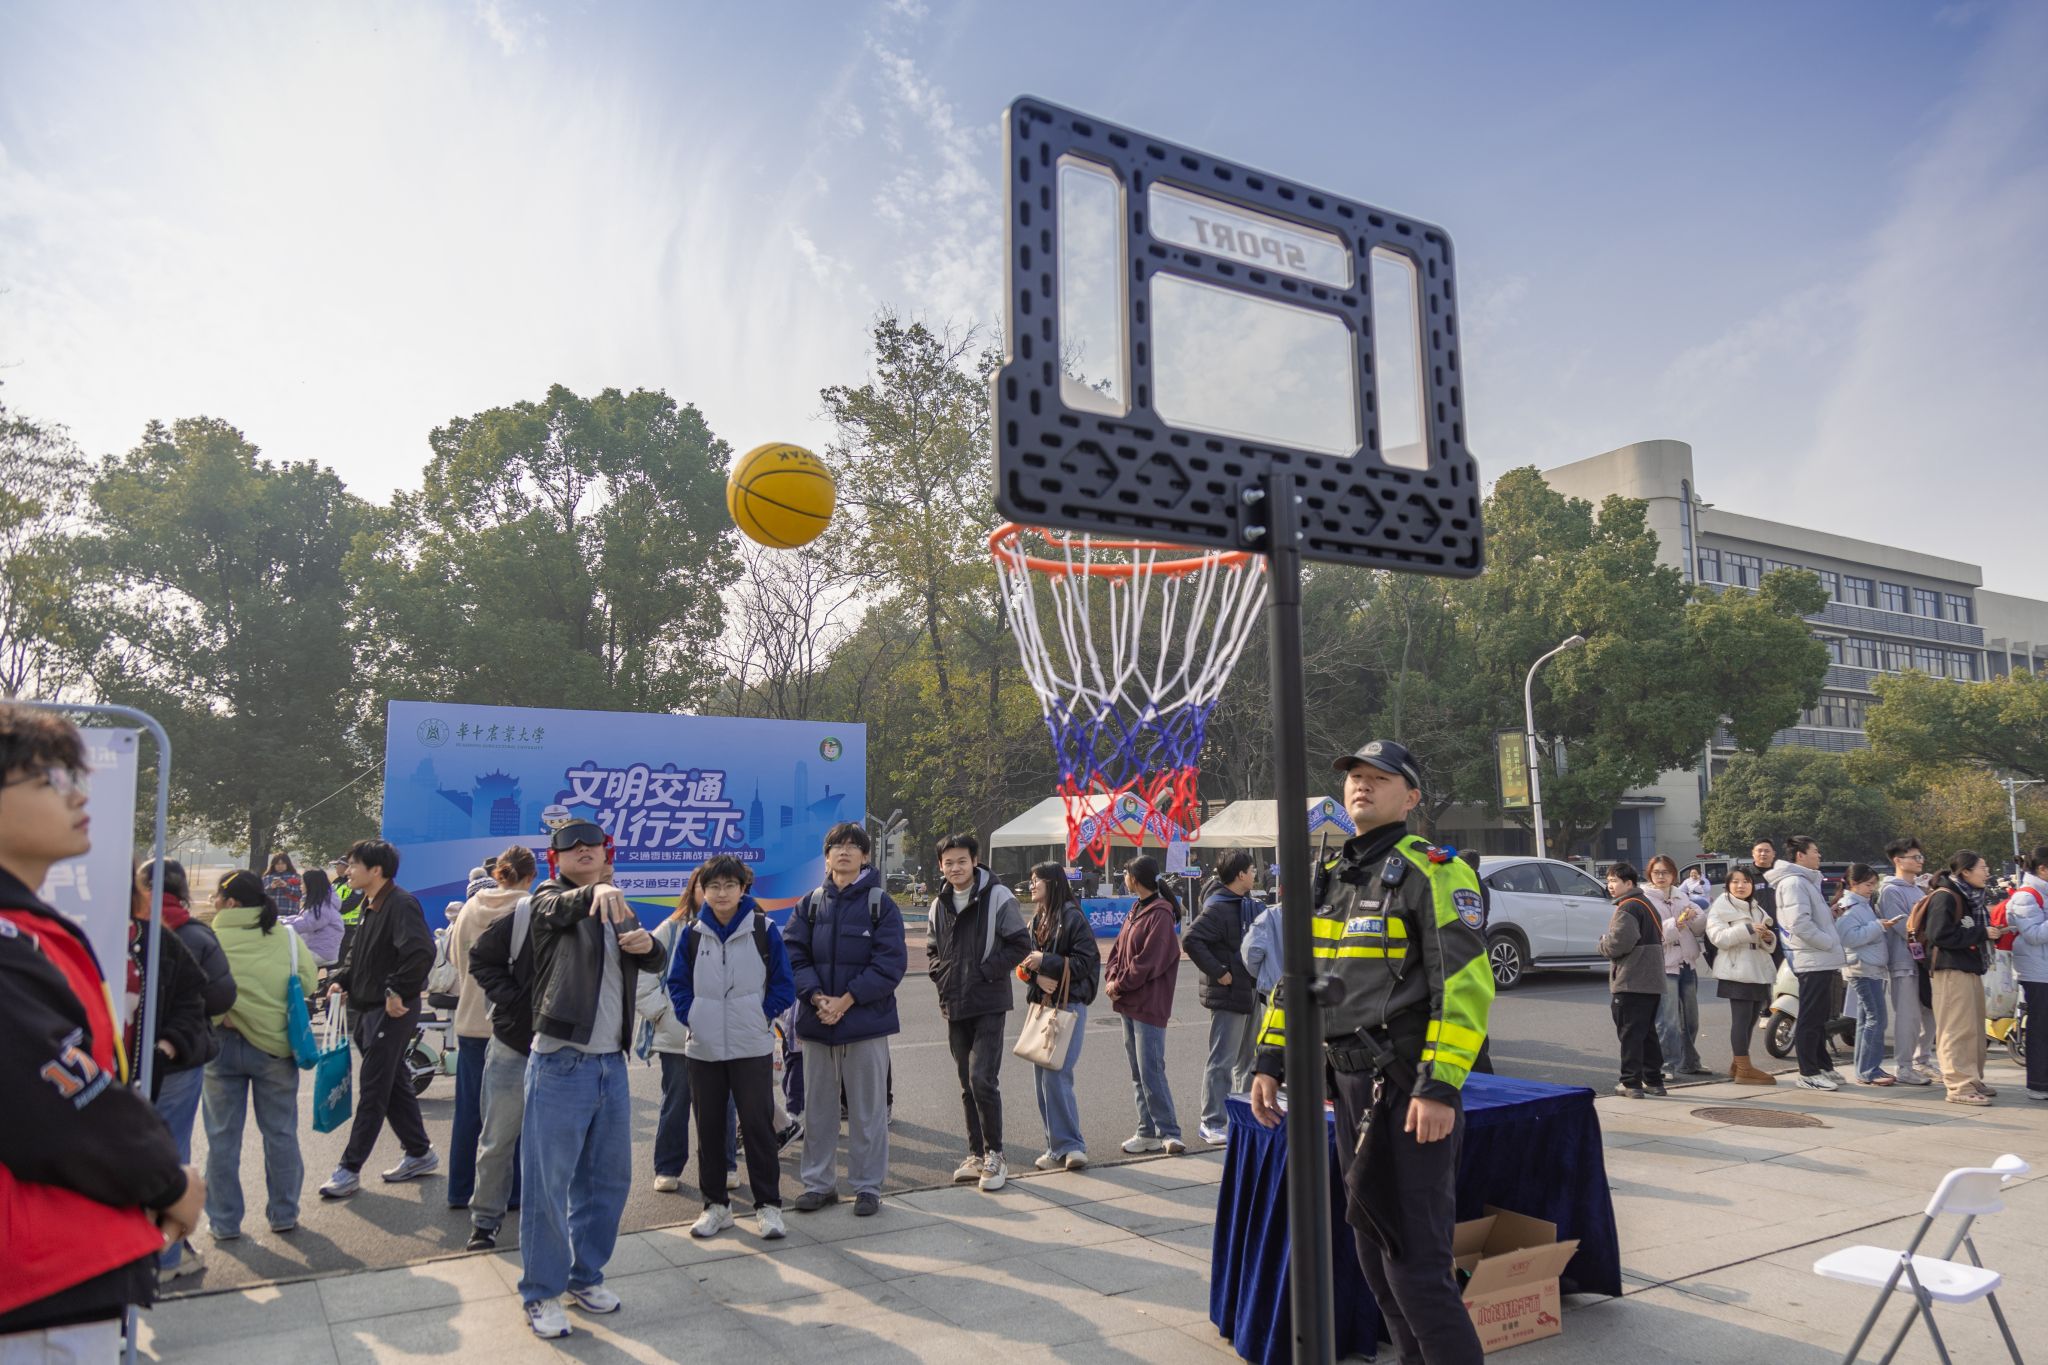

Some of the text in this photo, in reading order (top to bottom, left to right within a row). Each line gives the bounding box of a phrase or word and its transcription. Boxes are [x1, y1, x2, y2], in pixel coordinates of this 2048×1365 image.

[562, 766, 731, 808] 文明交通
[598, 808, 742, 848] 礼行天下
[1089, 911, 1128, 926] 交通文
[40, 1045, 100, 1098] 17
